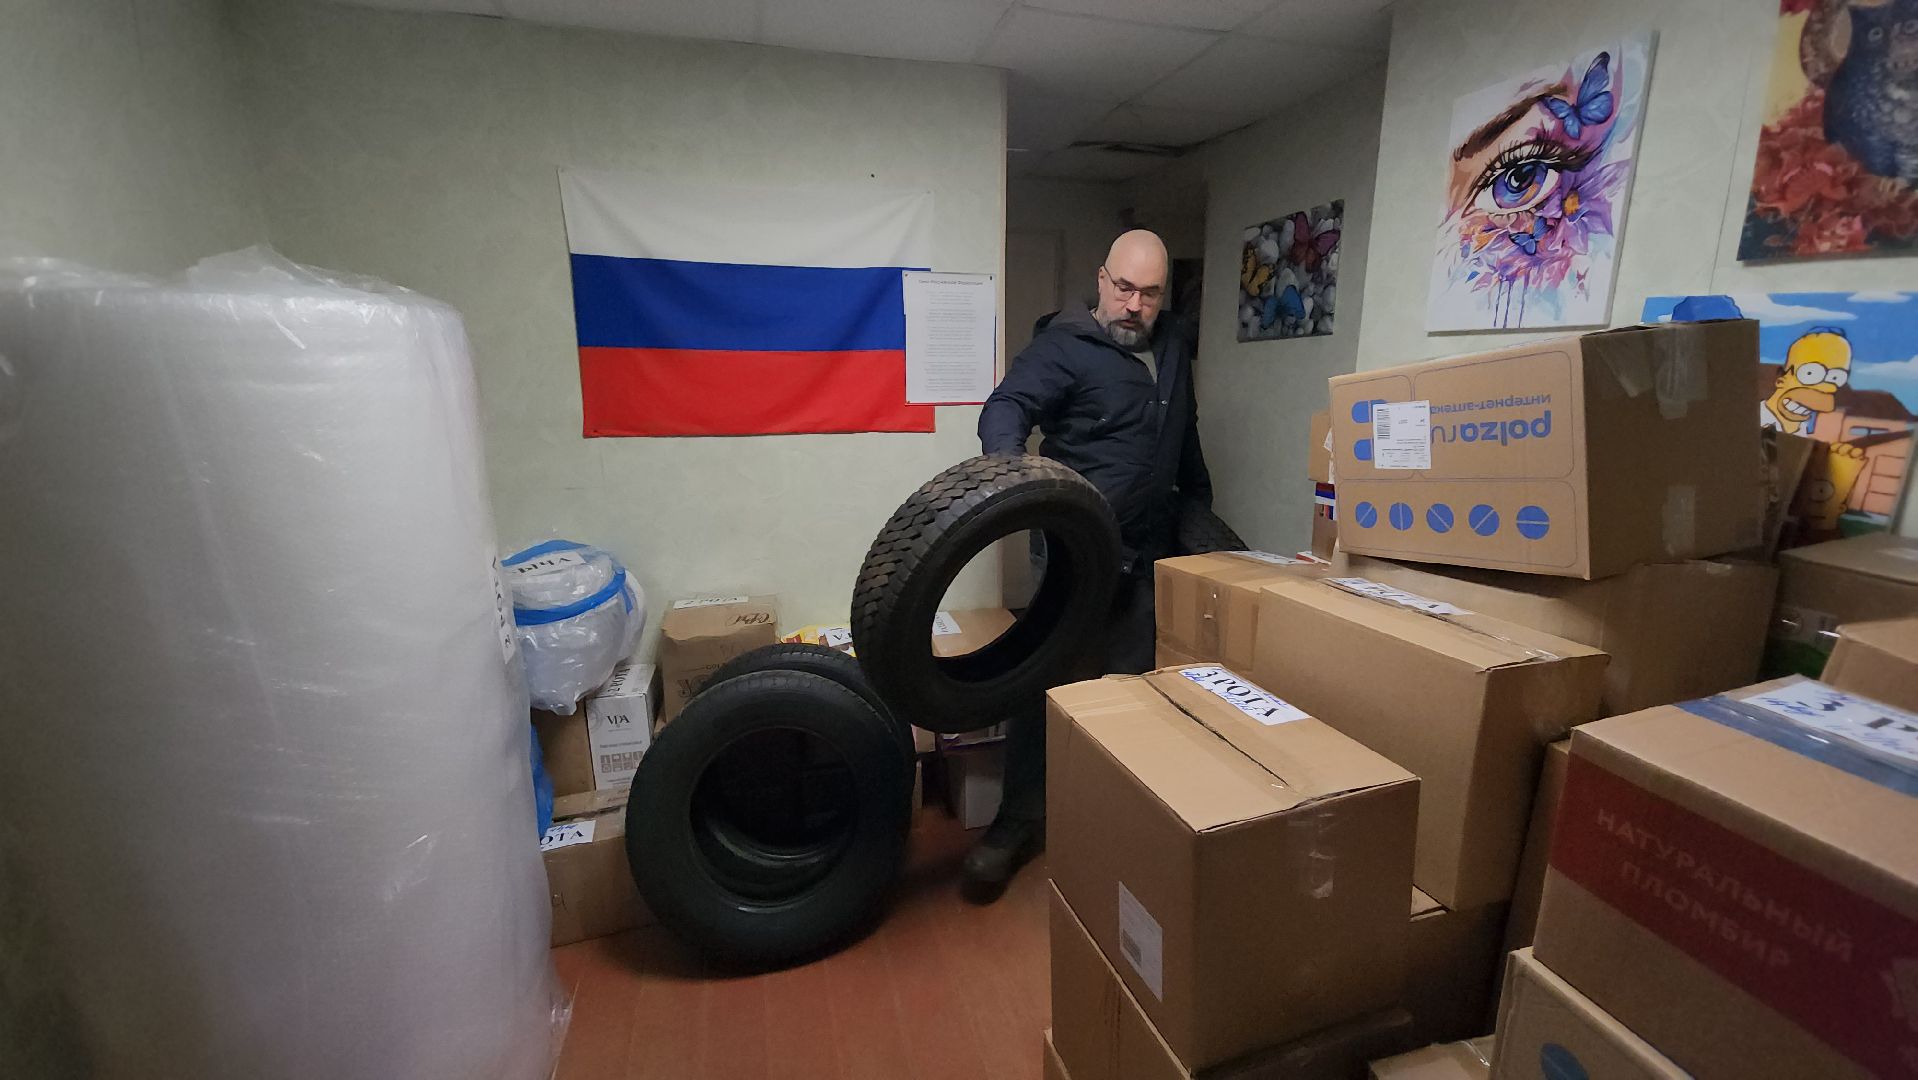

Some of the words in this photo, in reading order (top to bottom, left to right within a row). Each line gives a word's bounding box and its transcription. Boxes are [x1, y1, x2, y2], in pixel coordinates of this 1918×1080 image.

[1431, 394, 1552, 415] интернет-аптека
[1193, 669, 1219, 679] 3
[1212, 677, 1279, 718] РОТА
[1596, 807, 1853, 963] НАТУРАЛЬНЫЙ
[1620, 860, 1792, 968] ПЛОМБИР
